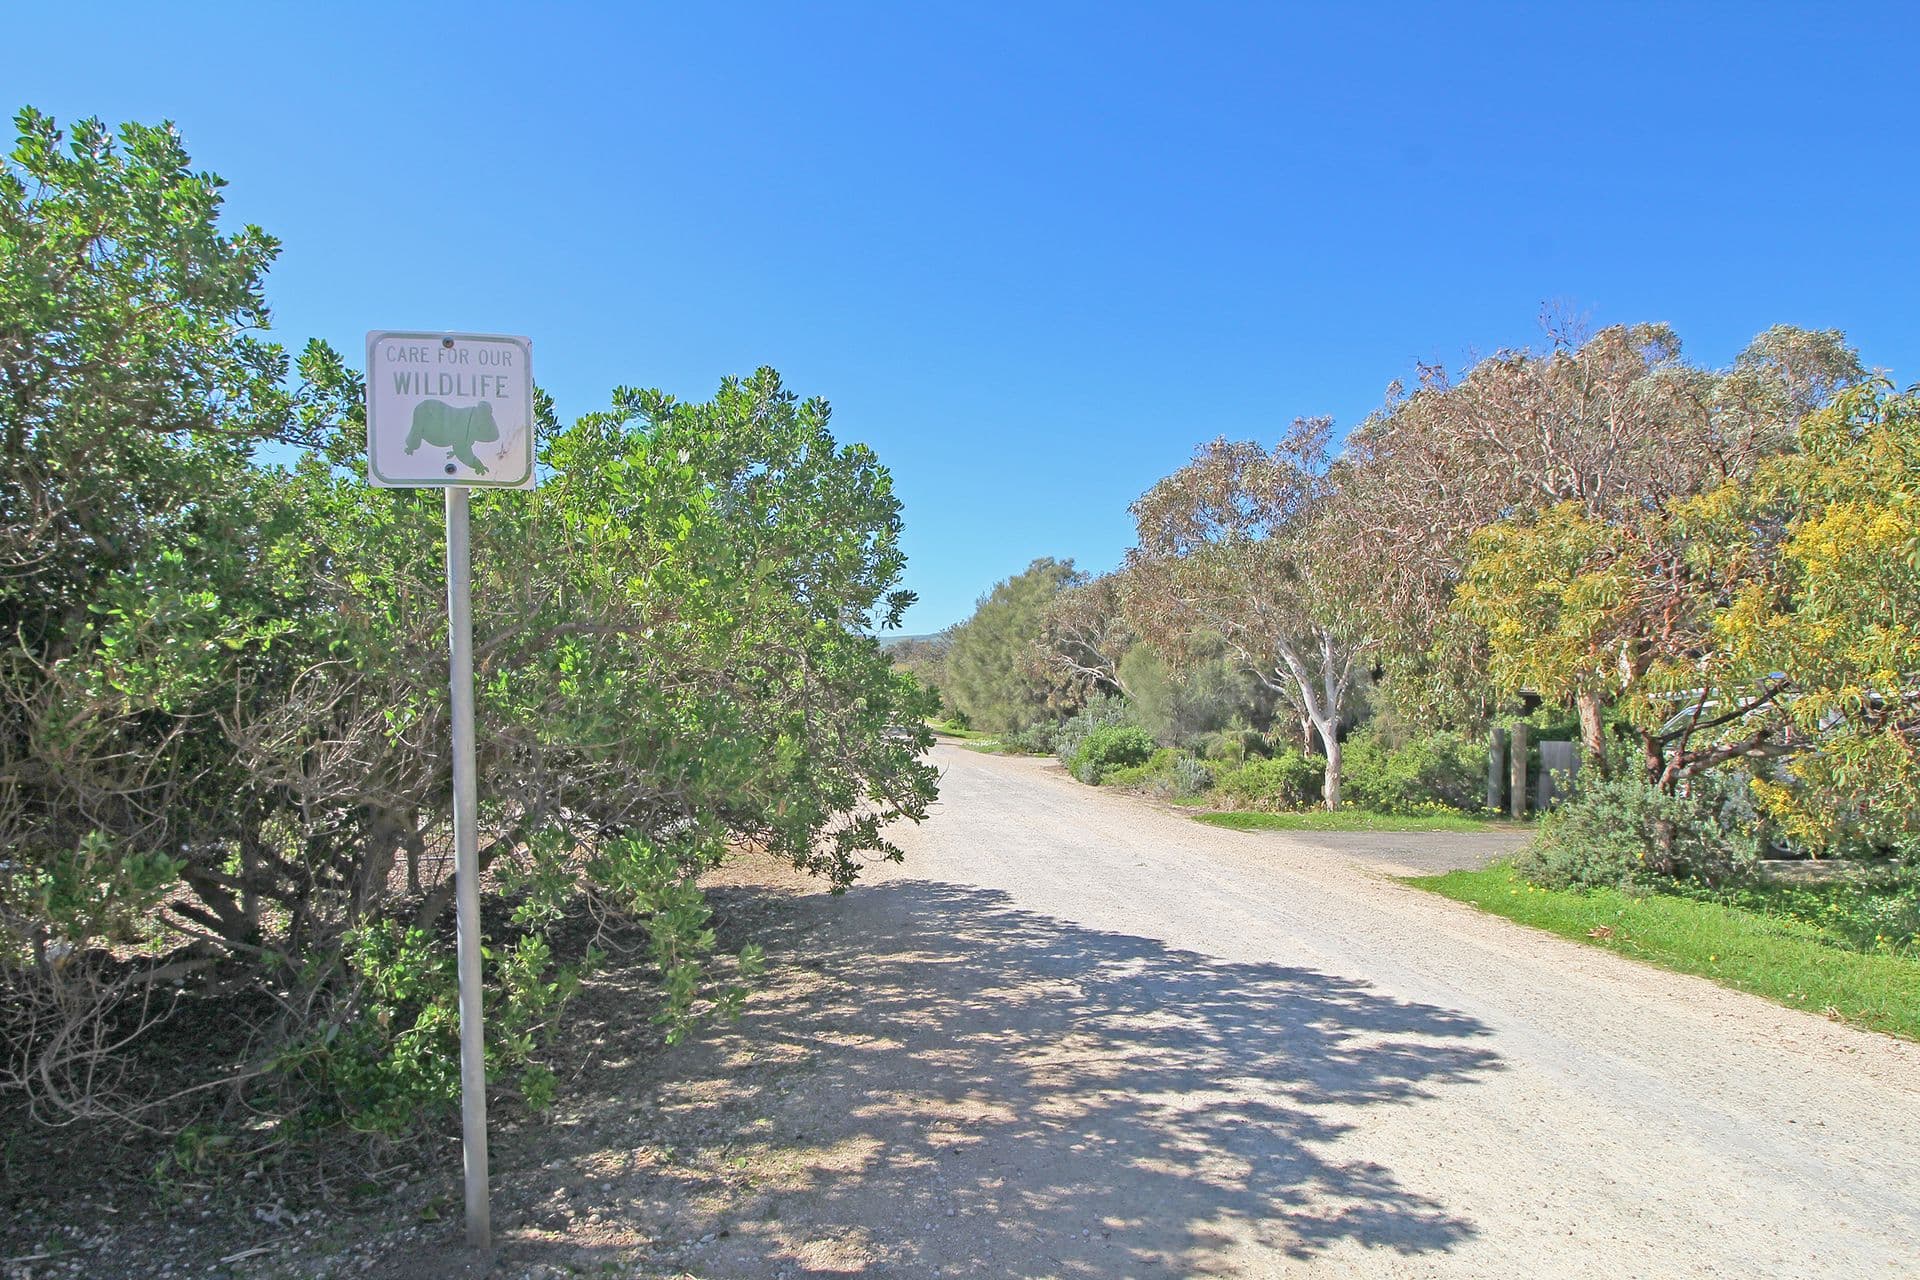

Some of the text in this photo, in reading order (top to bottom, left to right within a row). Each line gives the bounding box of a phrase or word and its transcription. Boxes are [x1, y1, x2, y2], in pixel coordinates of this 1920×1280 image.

[386, 346, 512, 367] CARE FOR OUR
[394, 371, 509, 398] WILDLIFE
